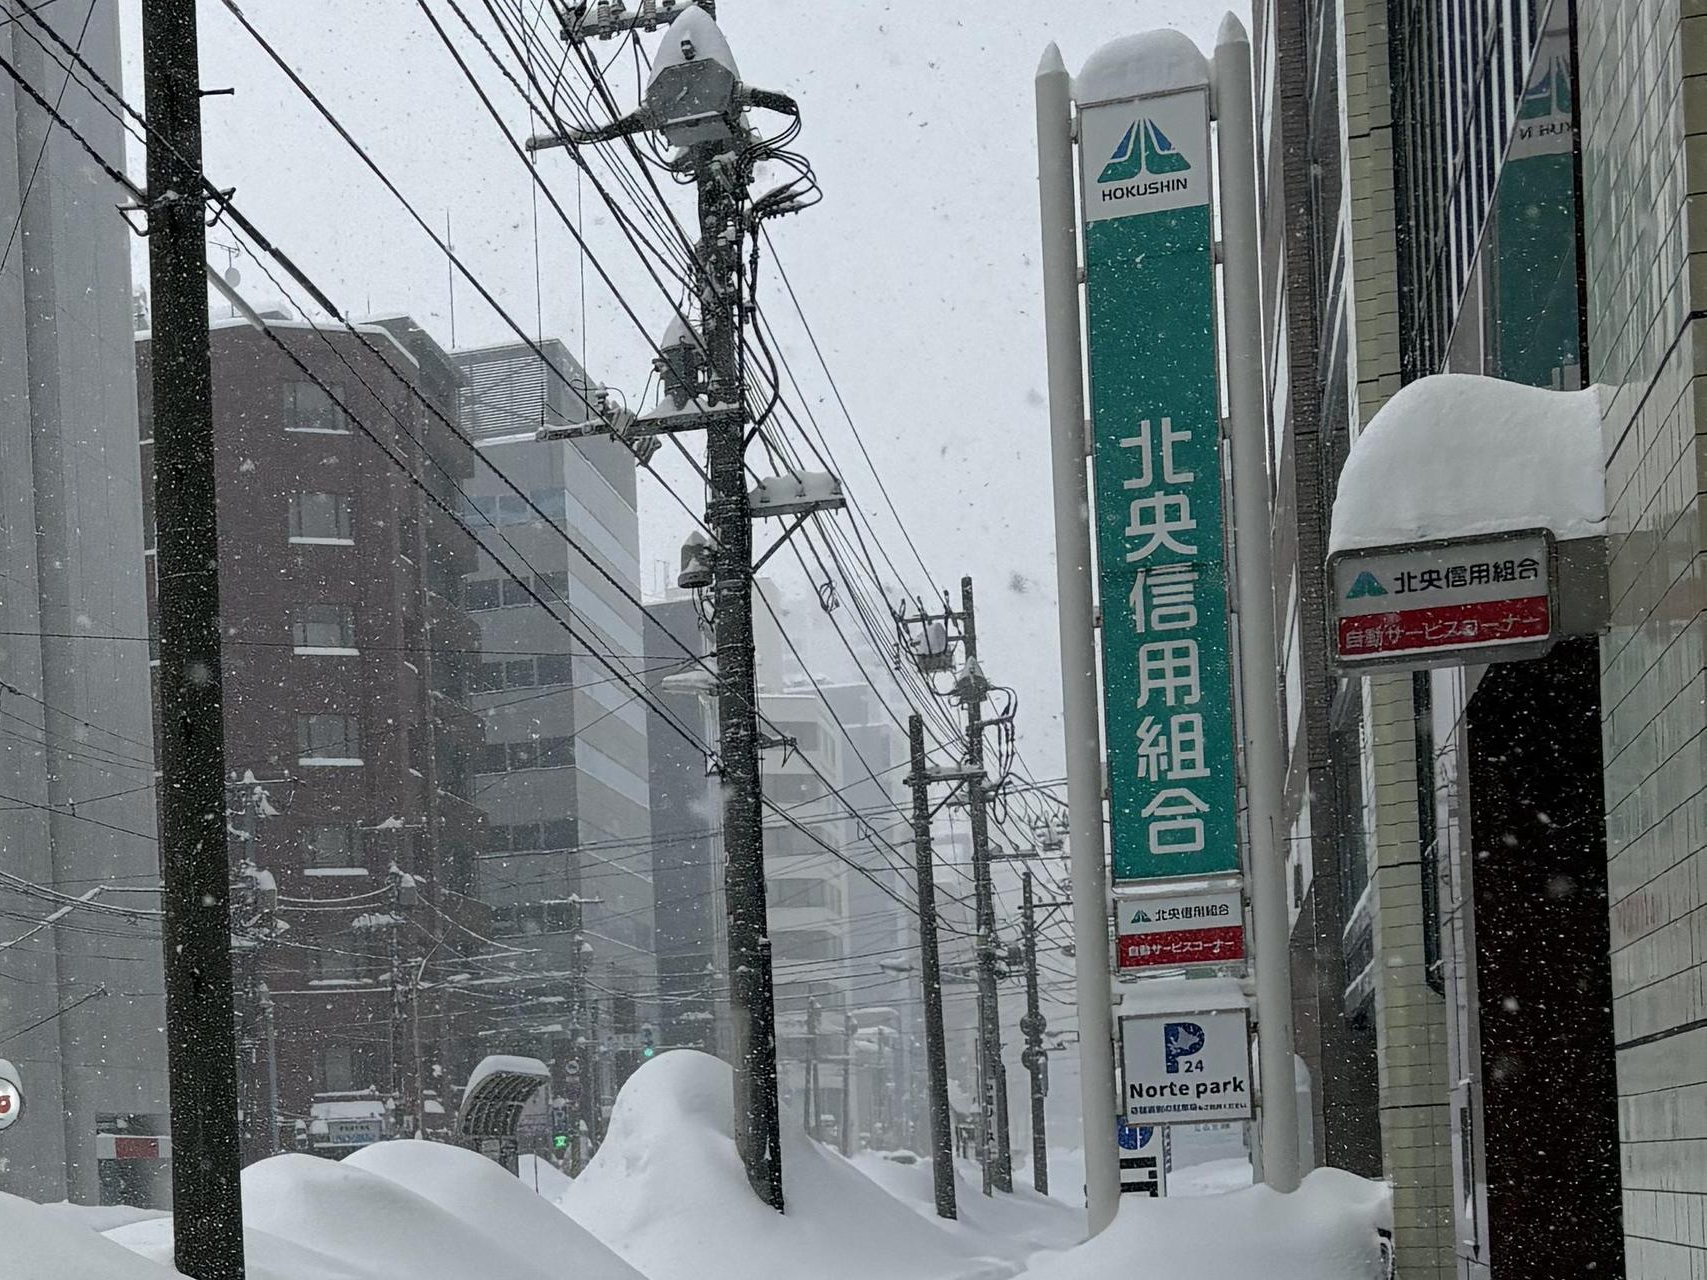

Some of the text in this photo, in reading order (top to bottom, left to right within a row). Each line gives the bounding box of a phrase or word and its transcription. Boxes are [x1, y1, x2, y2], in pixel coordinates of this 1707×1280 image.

[1102, 178, 1188, 201] HOKUSHIN
[1394, 558, 1539, 594] 北央信用組合
[1119, 417, 1211, 855] 北央信用組合
[1346, 613, 1541, 649] 自動サービスコーナー
[1184, 1060, 1204, 1073] 24
[1130, 1076, 1245, 1099] Norte park
